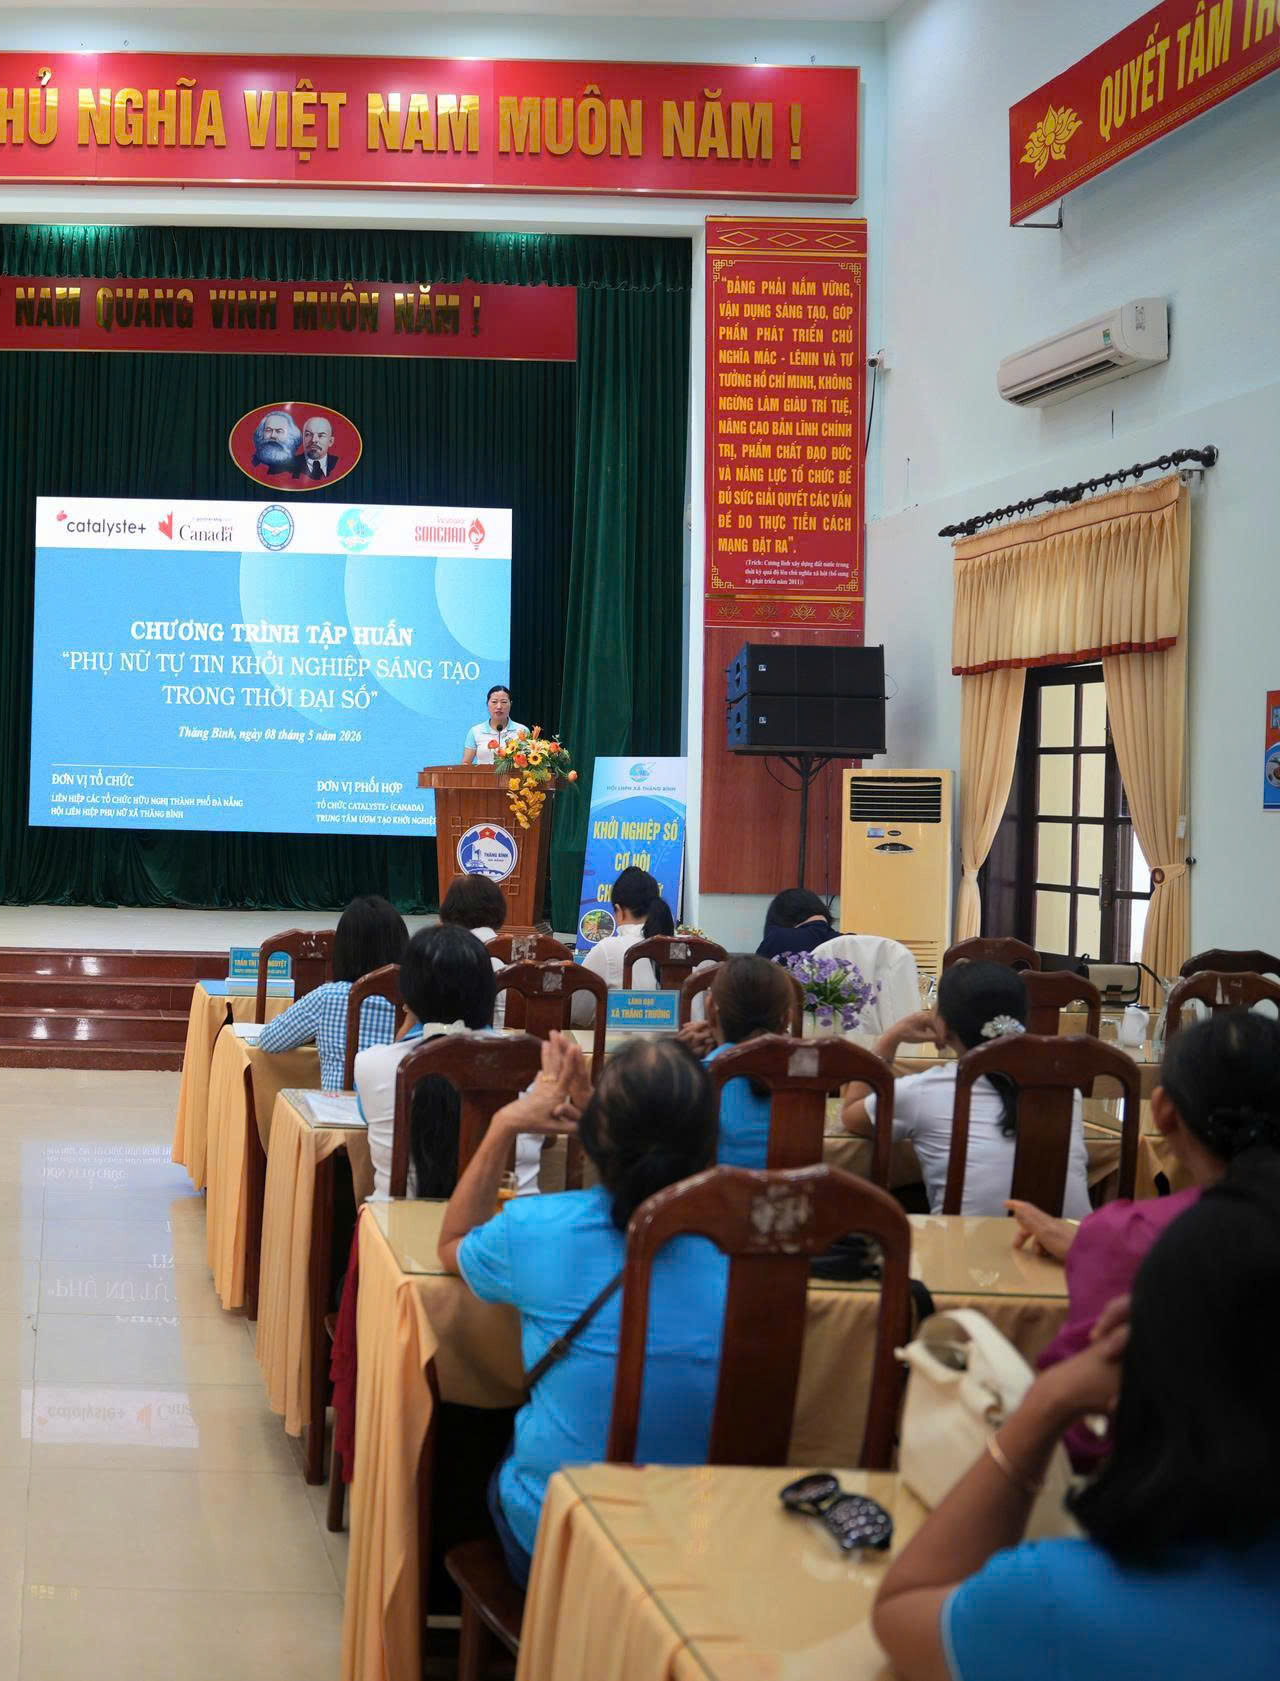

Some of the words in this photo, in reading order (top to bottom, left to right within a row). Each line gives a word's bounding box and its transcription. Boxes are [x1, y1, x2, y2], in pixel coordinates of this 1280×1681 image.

[1099, 23, 1170, 142] QUYẾT
[1177, 0, 1233, 90] TÂM
[77, 78, 225, 147] NGHĨA
[243, 78, 346, 161] VIỆT
[366, 91, 479, 152] NAM
[498, 84, 646, 158] MUÔN
[661, 88, 773, 160] NĂM
[790, 104, 802, 160] !
[762, 277, 786, 294] PHẢI
[792, 276, 816, 295] NẮM
[822, 280, 853, 298] VỮNG,
[15, 286, 81, 327] NAM
[96, 288, 194, 332] QUANG
[209, 289, 277, 331] VINH
[293, 282, 379, 333] MUÔN
[394, 284, 460, 336] NĂM
[473, 295, 480, 336] !
[719, 300, 739, 319] VẬN
[744, 304, 770, 321] DỤNG
[776, 302, 802, 319] SÁNG
[807, 305, 828, 322] TẠO,
[833, 304, 853, 320] GÓP
[719, 323, 748, 341] PHẦN
[757, 325, 784, 341] PHÁT
[793, 322, 823, 343] TRIỂN
[832, 325, 853, 343] CHỦ
[719, 348, 749, 364] NGHĨA
[754, 348, 777, 364] MÁC
[790, 349, 818, 366] LÊNIN
[823, 350, 836, 366] VÀ
[840, 352, 853, 367] TƯ
[719, 369, 751, 387] TƯỞNG
[754, 370, 766, 388] HỒ
[769, 372, 786, 388] CHÍ
[787, 375, 816, 391] MINH,
[818, 375, 852, 390] KHÔNG
[67, 519, 146, 536] catalyste+
[179, 524, 232, 542] Canada
[130, 619, 224, 641] CHƯƠNG
[231, 619, 299, 644] TRÌNH
[306, 621, 347, 650] TẬP
[353, 619, 414, 647] HUẤN
[63, 651, 113, 675] “PHỤ
[120, 650, 150, 672] NỮ
[156, 652, 185, 677] TỰ
[190, 654, 224, 673] TIN
[231, 650, 283, 676] KHỞI
[291, 655, 370, 681] NGHIỆP
[376, 656, 433, 679] SÁNG
[440, 661, 480, 684] TẠO
[161, 686, 235, 705] TRONG
[241, 685, 293, 707] THỜI
[300, 689, 334, 712] ĐẠI
[341, 684, 378, 709] SỐ”
[178, 726, 209, 740] Thăng
[211, 727, 236, 740] Bình,
[239, 728, 262, 742] ngày
[265, 728, 276, 740] 08
[278, 729, 305, 743] tháng
[308, 730, 314, 740] 5
[316, 730, 336, 740] năm
[339, 730, 361, 741] 2026
[52, 773, 74, 784] ĐƠN
[76, 775, 87, 788] VỊ
[89, 770, 103, 785] TỔ
[105, 773, 134, 786] CHỨC
[317, 781, 338, 792] ĐƠN
[341, 782, 352, 794] VỊ
[354, 776, 379, 793] PHỐI
[382, 783, 402, 795] HỢP
[391, 803, 424, 812] (CANADA)
[593, 816, 618, 839] KHỞI
[621, 819, 661, 844] NGHIỆP
[663, 817, 679, 840] SỐ
[615, 852, 630, 871] CƠ
